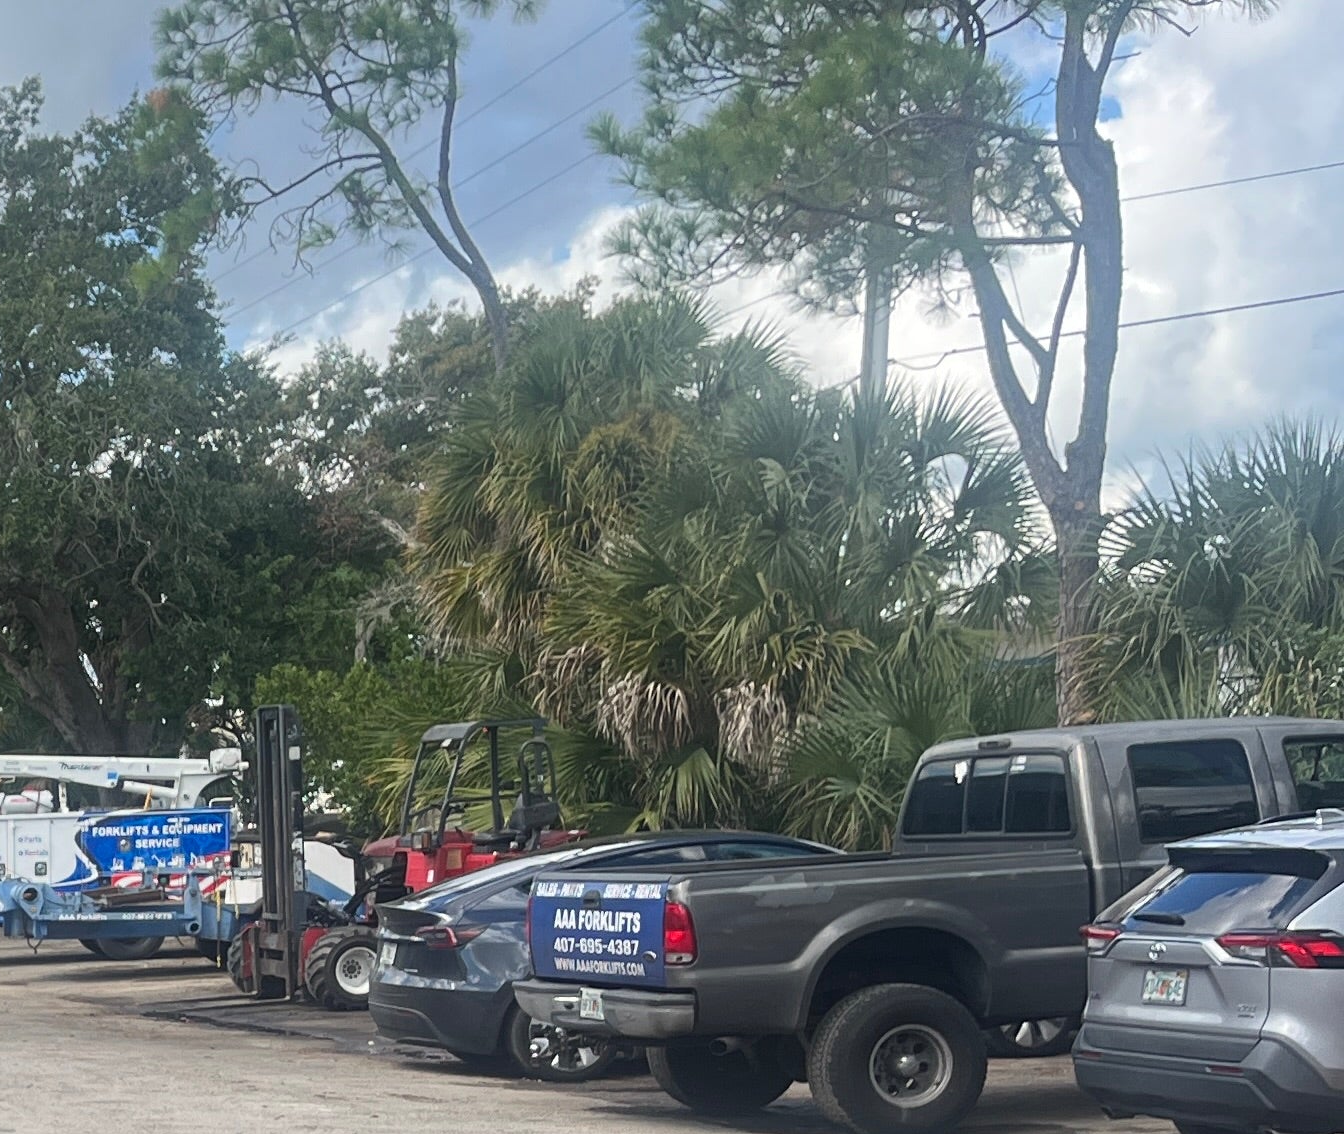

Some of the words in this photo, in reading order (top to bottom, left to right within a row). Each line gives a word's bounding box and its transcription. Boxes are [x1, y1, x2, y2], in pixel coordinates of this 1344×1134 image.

[92, 824, 149, 837] FORKLIFTS
[151, 825, 160, 835] &
[162, 822, 224, 835] EQUIPMENT
[135, 838, 180, 849] SERVICE
[536, 882, 558, 897] SALES
[560, 883, 585, 898] PARTS
[603, 884, 633, 899] SERVICE
[634, 884, 662, 899] RENTAL
[554, 908, 576, 930] AAA
[578, 909, 641, 933] FORKLIFTS
[554, 937, 639, 956] 407-695-4387
